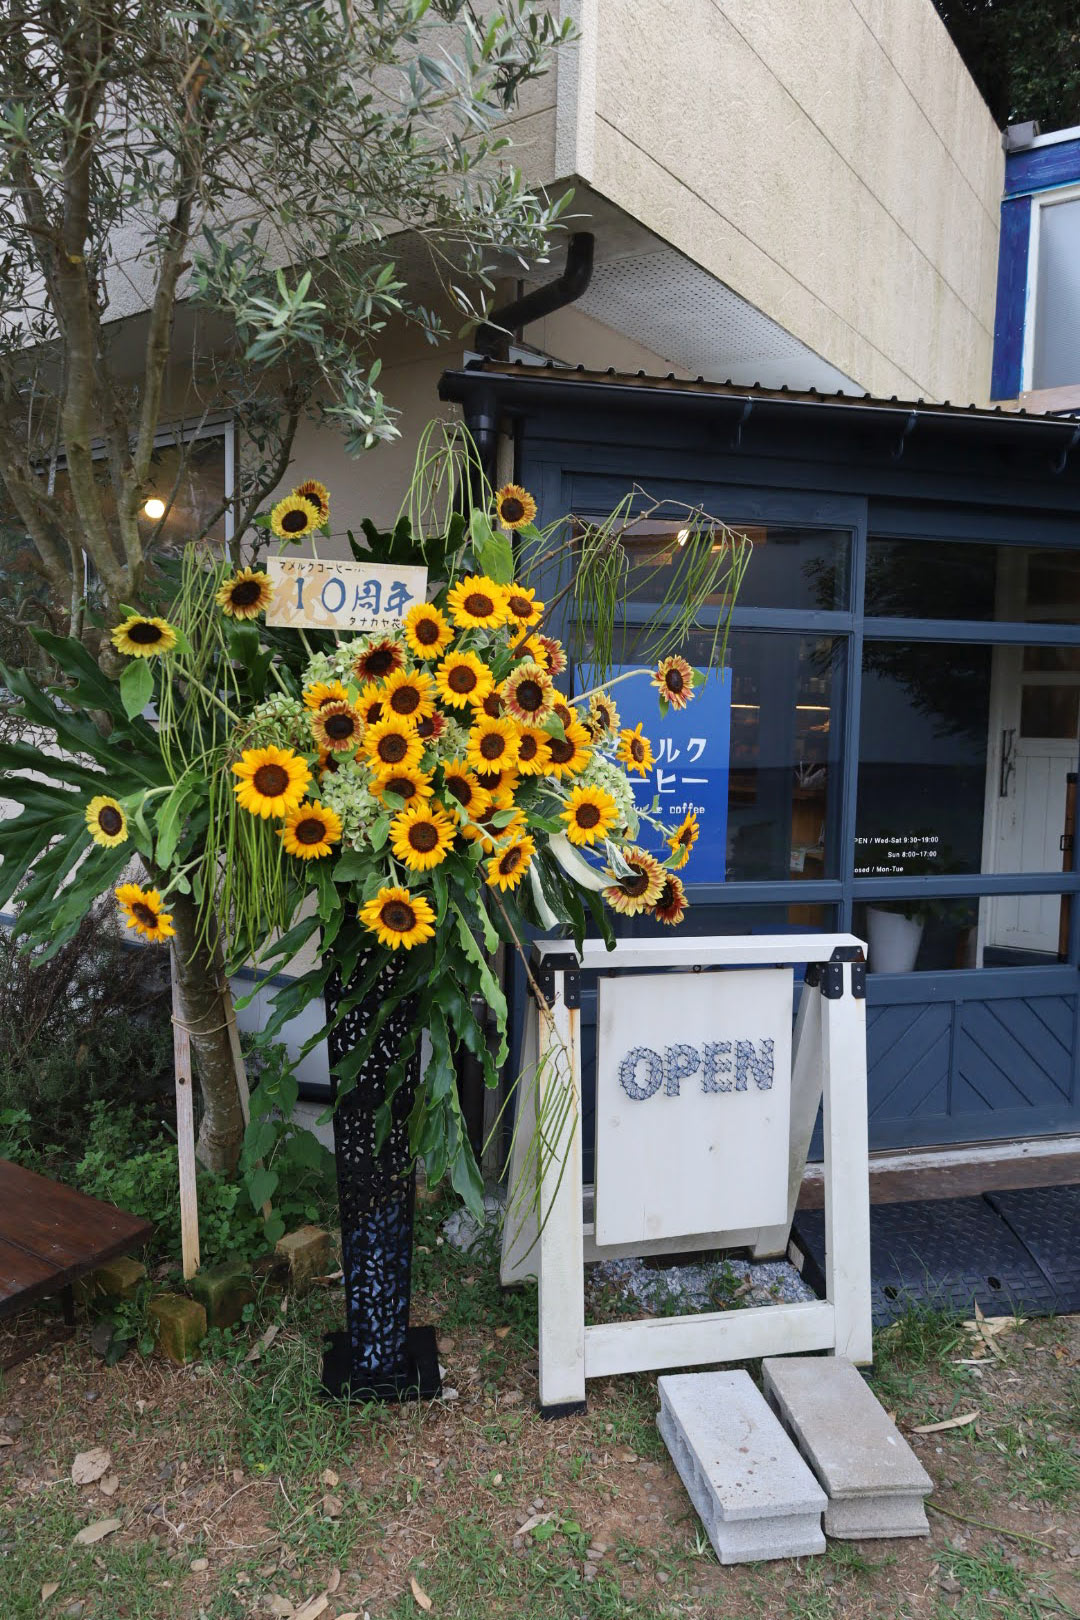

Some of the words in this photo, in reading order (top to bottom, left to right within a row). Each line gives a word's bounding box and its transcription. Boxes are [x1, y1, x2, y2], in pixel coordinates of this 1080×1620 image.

[669, 802, 706, 814] coffee
[876, 865, 904, 873] Mon-Tue
[618, 1037, 775, 1101] OPEN
